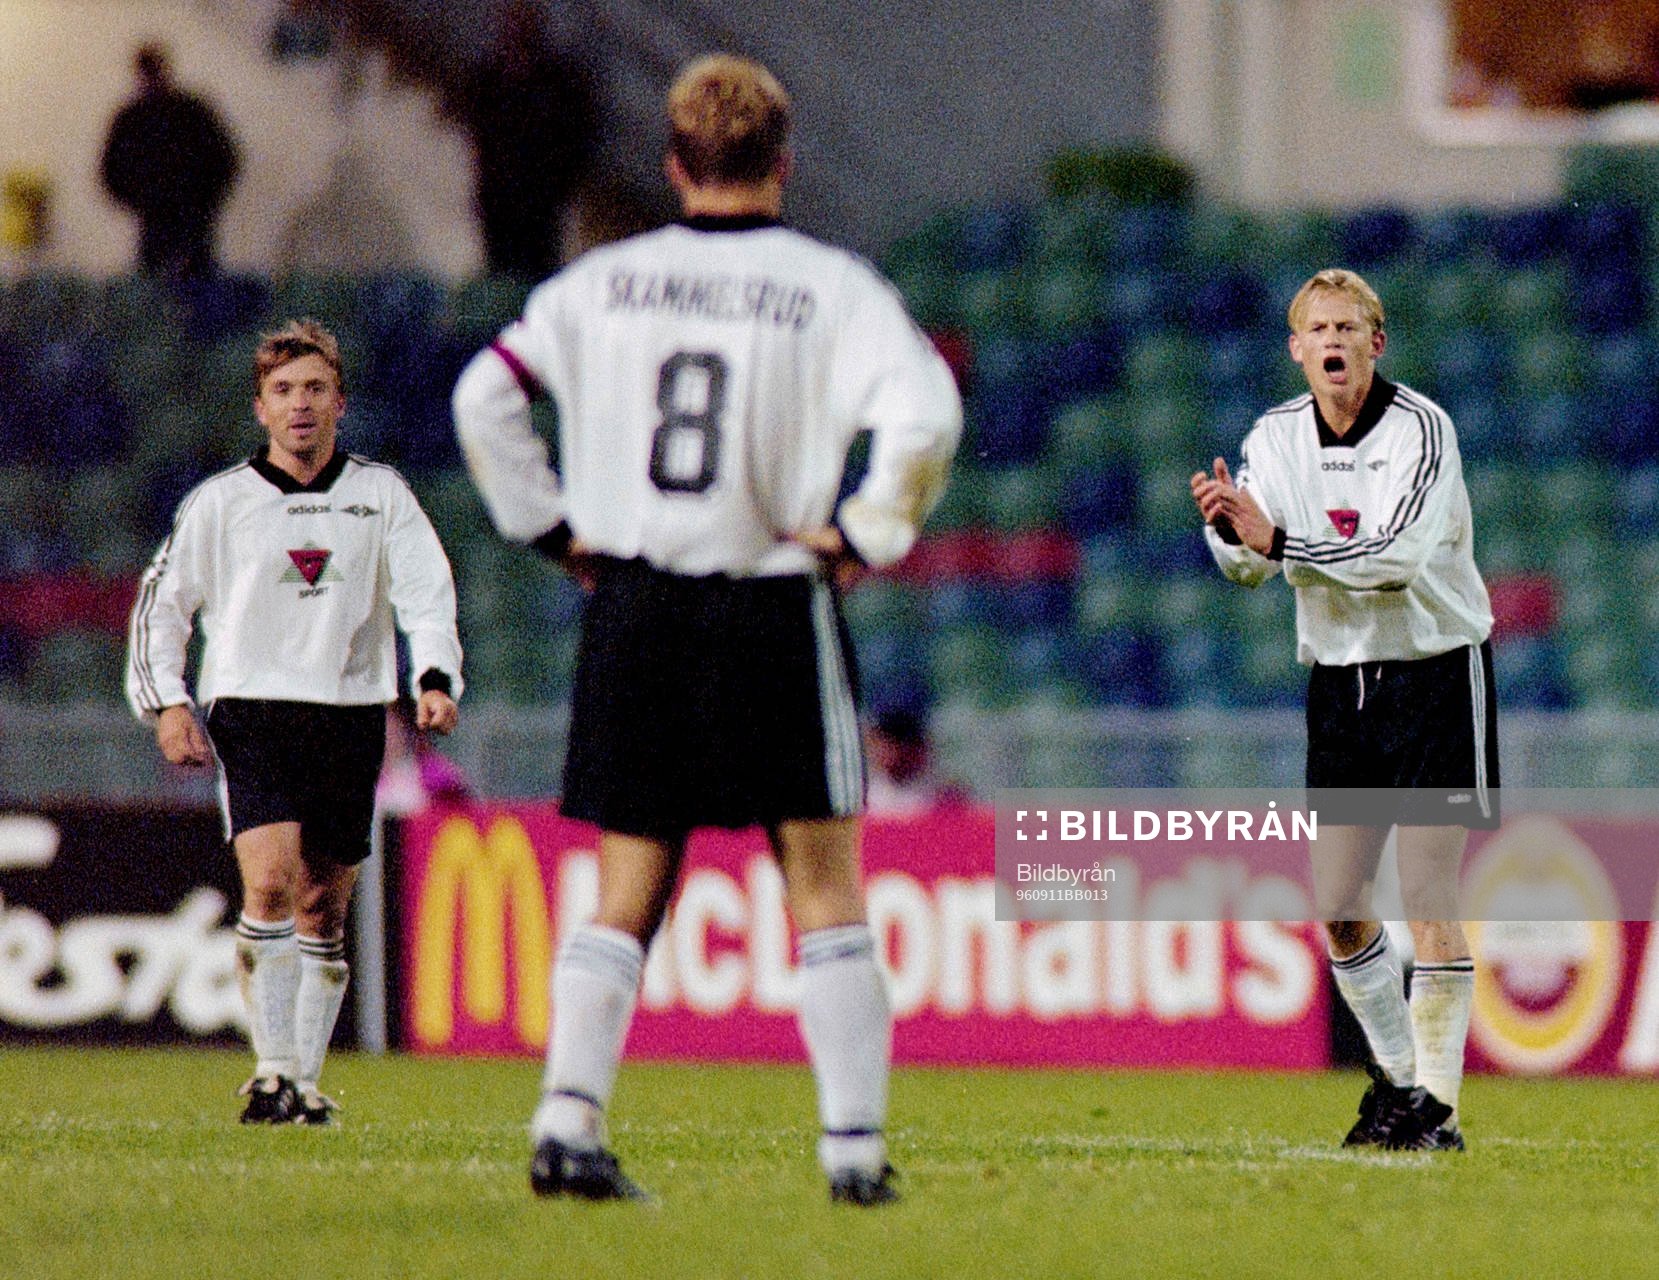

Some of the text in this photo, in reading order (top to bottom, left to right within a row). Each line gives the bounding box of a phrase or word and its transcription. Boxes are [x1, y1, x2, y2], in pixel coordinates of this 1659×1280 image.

[649, 350, 730, 494] 8
[1321, 460, 1356, 472] adidas
[287, 503, 332, 515] adidas
